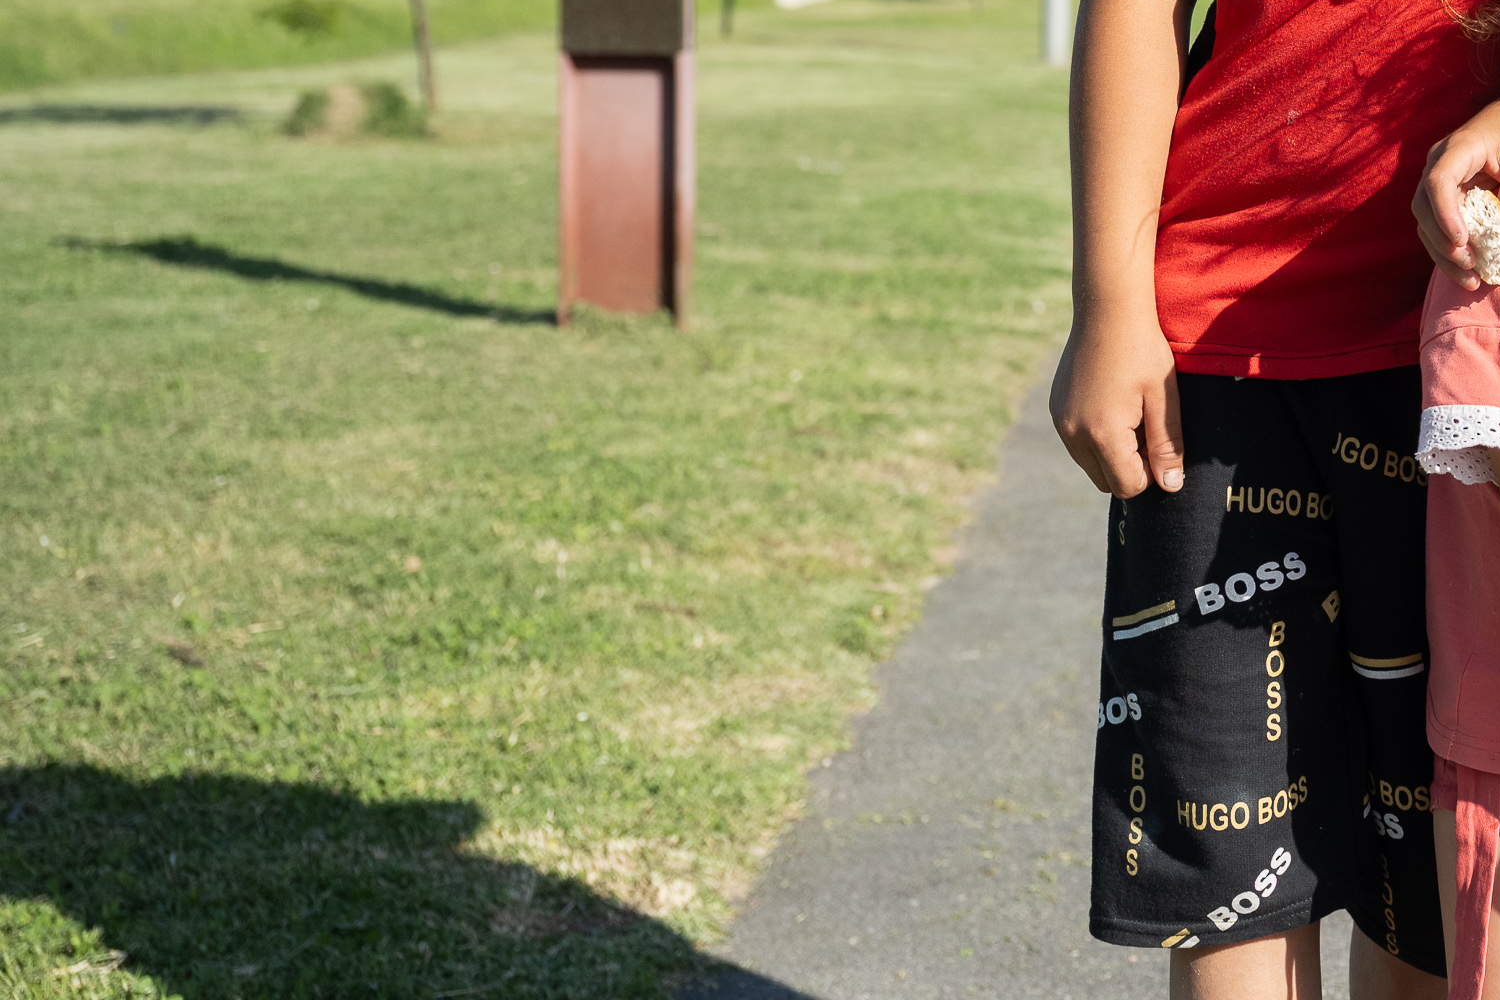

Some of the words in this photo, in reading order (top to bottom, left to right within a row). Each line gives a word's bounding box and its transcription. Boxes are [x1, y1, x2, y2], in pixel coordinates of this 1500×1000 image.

[1226, 486, 1301, 517] HUGO
[1195, 552, 1306, 616] BOSS
[1266, 621, 1286, 742] BOSS
[1126, 753, 1146, 876] BOSS
[1177, 799, 1250, 832] HUGO
[1258, 776, 1308, 825] BOSS
[1207, 847, 1292, 931] BOSS
